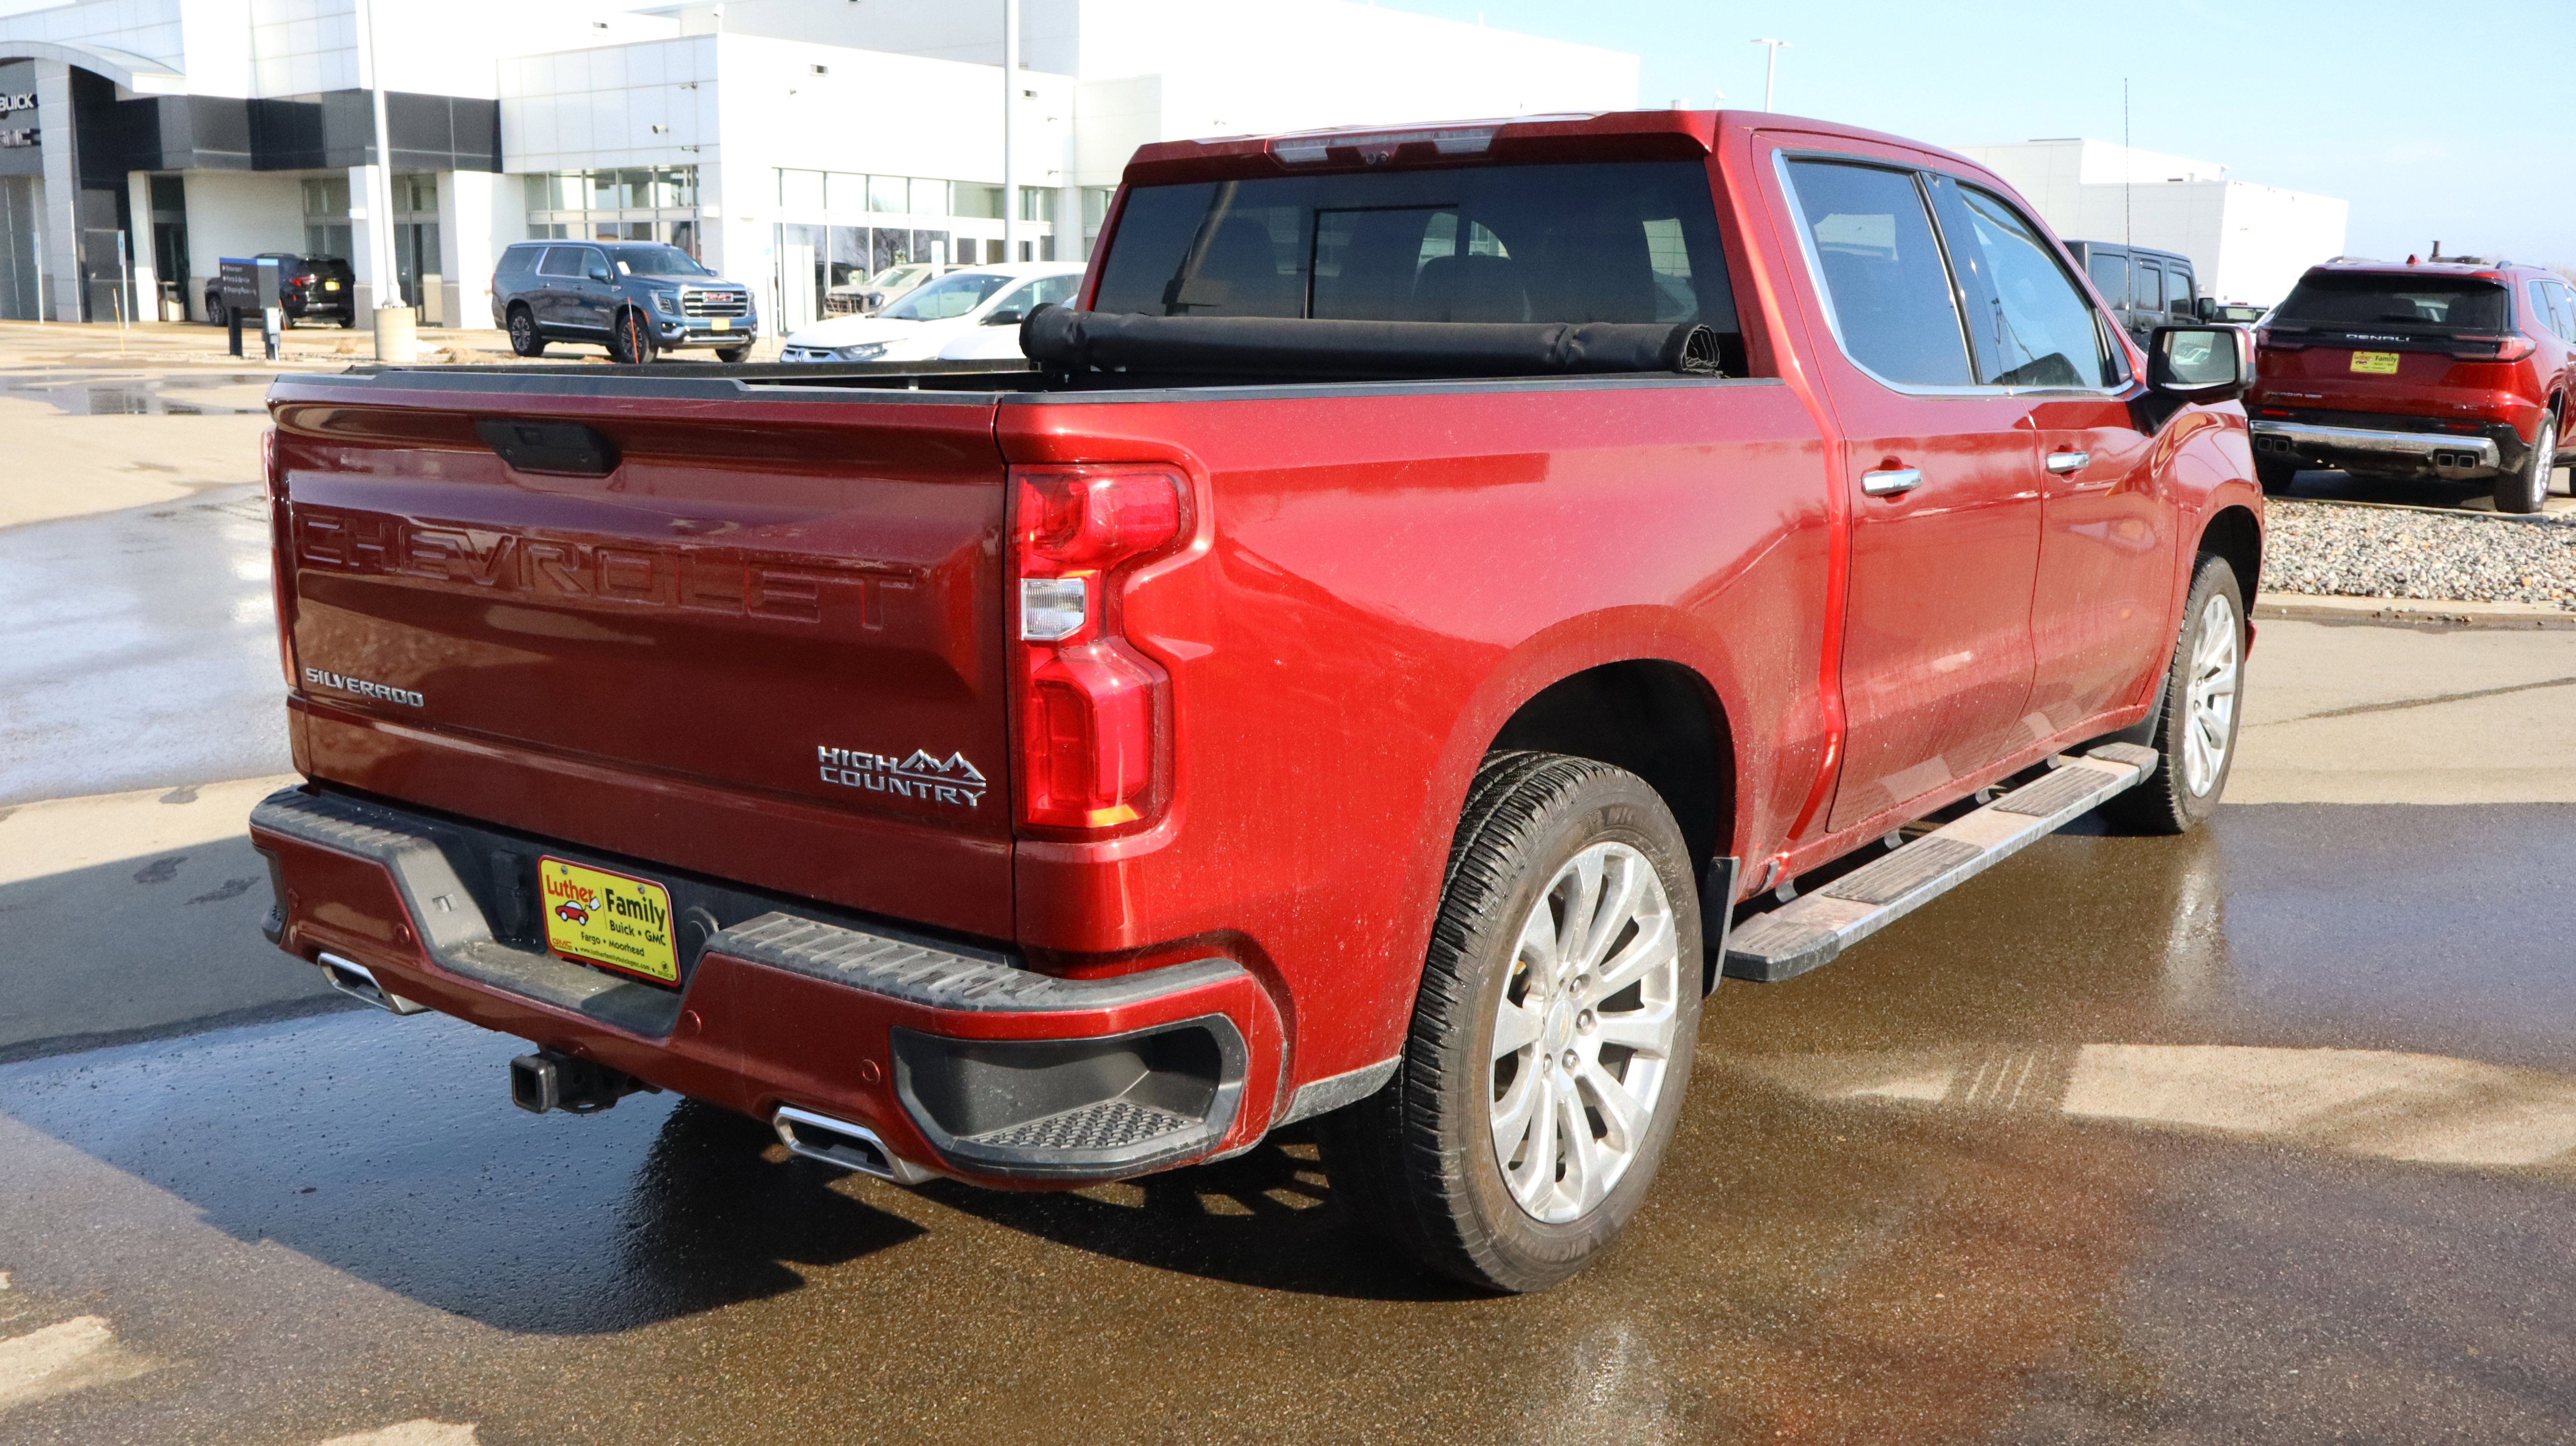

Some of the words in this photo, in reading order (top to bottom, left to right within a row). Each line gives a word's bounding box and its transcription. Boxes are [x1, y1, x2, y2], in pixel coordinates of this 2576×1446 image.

[0, 93, 34, 111] BUICK
[301, 513, 915, 631] CHEVROLET
[305, 667, 424, 708] SILVERADO
[818, 746, 898, 774] HIGH
[820, 766, 986, 806] COUNTRY
[546, 875, 593, 903] Luther
[605, 888, 665, 932] Family
[552, 938, 572, 948] GMC
[581, 932, 601, 945] Fargo
[609, 940, 644, 956] Moorhead
[609, 920, 635, 937] Buick
[645, 930, 666, 946] GMC
[658, 970, 675, 979] BUICK
